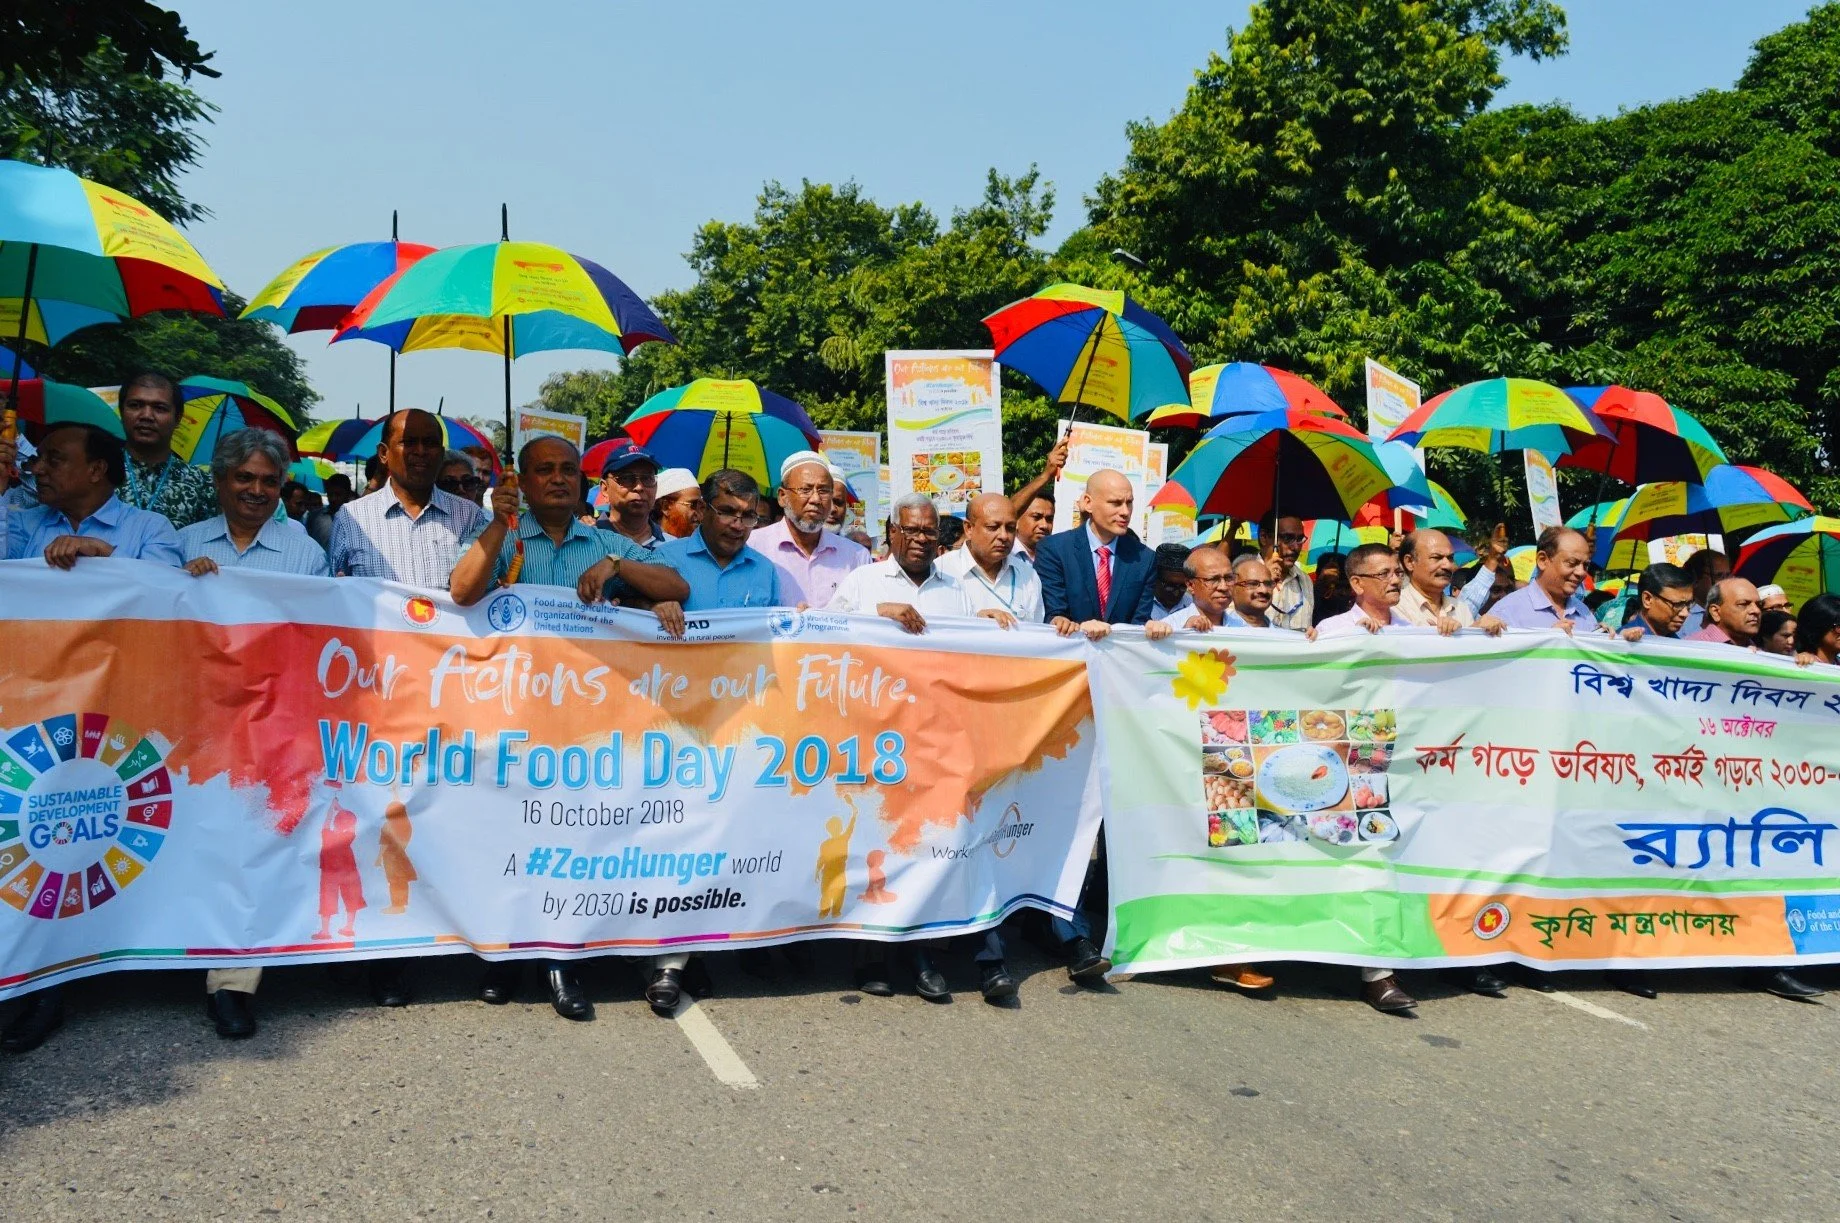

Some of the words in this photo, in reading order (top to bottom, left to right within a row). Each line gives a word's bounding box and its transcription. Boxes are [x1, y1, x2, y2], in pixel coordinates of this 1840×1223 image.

[534, 598, 555, 607] Food
[557, 601, 573, 609] and
[575, 602, 620, 614] Agriculture
[534, 610, 587, 621] Organization
[600, 617, 614, 626] the
[534, 622, 561, 632] United
[563, 624, 594, 634] Nations
[685, 620, 710, 630] AD
[807, 615, 831, 624] World
[807, 624, 850, 632] Programme
[317, 637, 408, 700] Our
[430, 644, 610, 716] Actions
[629, 663, 689, 707] are
[709, 664, 778, 706] our
[796, 651, 917, 717] Future.
[1571, 663, 1634, 698] বিশ্ব
[1648, 676, 1721, 702] খাদ্য
[1731, 679, 1816, 709] দিবস
[1720, 714, 1777, 739] অক্টোবর
[318, 719, 475, 787] World
[496, 729, 623, 790] Food
[642, 730, 737, 801] Day
[753, 730, 909, 788] 2018
[1415, 733, 1466, 775] কর্ম
[1472, 742, 1539, 786] গড়ে
[1652, 744, 1708, 789] কর্মই
[1714, 753, 1763, 793] গড়বে
[29, 785, 122, 808] SUSTAINABLE
[29, 801, 120, 823] DEVELOPMENT
[522, 800, 542, 824] 16
[550, 802, 634, 826] October
[640, 800, 684, 824] 2018
[504, 853, 516, 876] A
[526, 847, 727, 885] #ZeroHunger
[732, 850, 783, 874] world
[543, 891, 567, 920] by
[573, 893, 624, 916] 2030
[629, 892, 648, 914] is
[652, 888, 747, 918] possible.
[1807, 910, 1826, 919] Food
[1528, 908, 1597, 949] কৃষি
[1606, 910, 1740, 937] মন্ত্রণালয়
[1810, 922, 1819, 931] of
[1820, 922, 1832, 931] the
